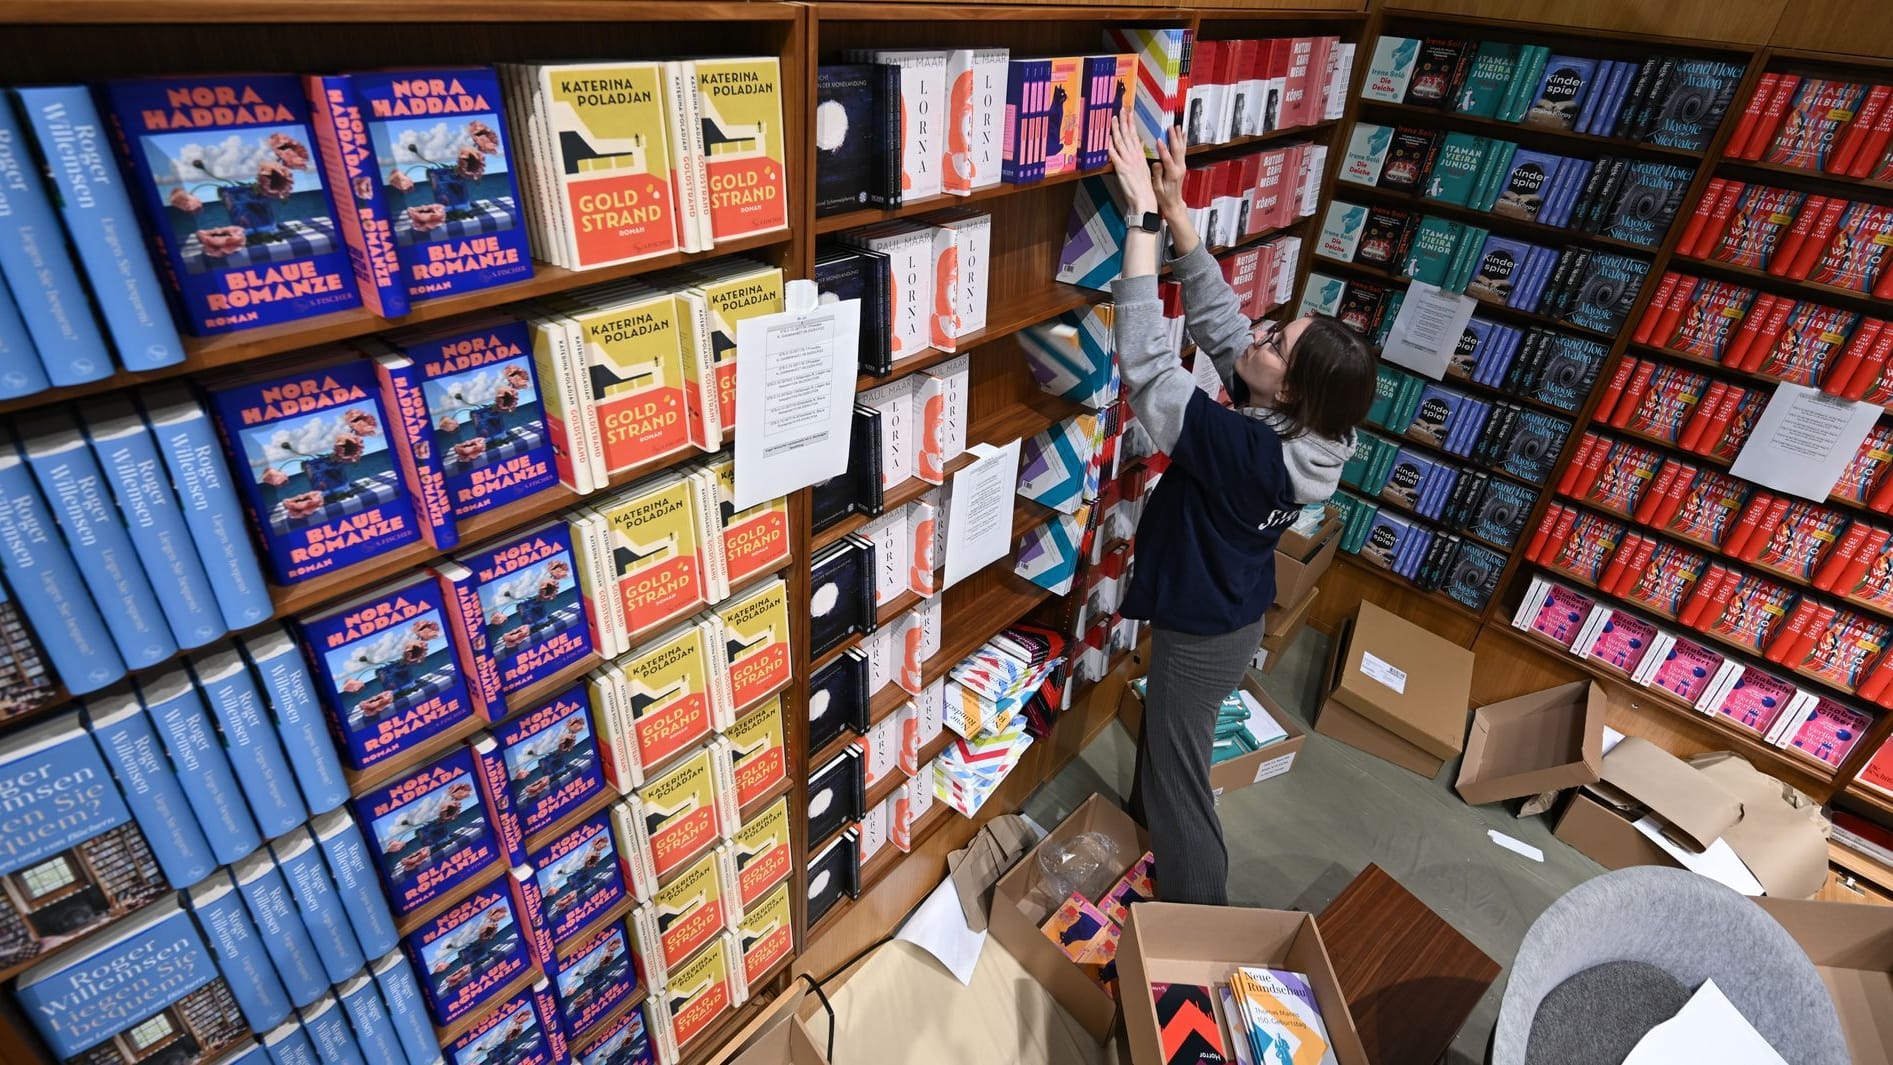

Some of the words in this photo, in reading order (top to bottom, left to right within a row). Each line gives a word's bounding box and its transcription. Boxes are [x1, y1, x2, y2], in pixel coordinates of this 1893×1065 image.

[886, 57, 913, 68] PAUL
[916, 56, 944, 68] MAAR
[982, 54, 1008, 65] MAAR
[1478, 63, 1511, 73] VIEIRA
[1677, 60, 1710, 75] Grand
[1711, 61, 1745, 78] Hotel
[561, 78, 633, 95] KATERINA
[701, 72, 759, 84] KATERINA
[1380, 76, 1391, 84] Die
[1471, 71, 1510, 81] JUNIOR
[1546, 73, 1586, 88] Kinder
[1683, 73, 1723, 90] Avalon
[167, 85, 263, 108] NORA
[394, 79, 467, 97] NORA
[577, 90, 652, 107] POLADJAN
[675, 76, 683, 111] KATERINA
[713, 83, 773, 96] POLADJAN
[1371, 84, 1395, 92] Deiche
[1547, 85, 1576, 96] spiel
[1802, 84, 1865, 98] ELIZABETH
[372, 94, 490, 117] HADDADA
[1803, 96, 1851, 109] GILBERT
[142, 104, 295, 130] HADDADA
[918, 79, 929, 174] LORNA
[983, 75, 993, 163] LORNA
[1662, 119, 1703, 137] Maggie
[1796, 117, 1816, 126] ALL
[1818, 120, 1838, 129] THE
[327, 89, 360, 179] HADDADA
[347, 105, 370, 162] NORA
[679, 112, 688, 151] POLADJAN
[1785, 126, 1816, 138] WAY
[1818, 130, 1835, 141] TO
[75, 124, 109, 184] Roger
[1446, 144, 1482, 157] ITAMAR
[1775, 136, 1795, 147] THE
[1795, 139, 1833, 153] RIVER
[43, 104, 95, 208] Willemsen
[1356, 160, 1368, 168] Die
[1440, 160, 1477, 172] JUNIOR
[1446, 152, 1478, 165] VIEIRA
[710, 171, 758, 191] GOLD
[1511, 168, 1549, 183] Kinder
[1631, 161, 1664, 176] Grand
[1665, 164, 1695, 181] Hotel
[683, 156, 696, 218] GOLDSTRAND
[1512, 177, 1540, 190] spiel
[1638, 175, 1674, 190] Avalon
[579, 190, 638, 213] GOLD
[712, 186, 776, 209] STRAND
[1746, 200, 1790, 214] GILBERT
[581, 207, 661, 233] STRAND
[741, 205, 762, 213] ROMAN
[619, 226, 645, 237] ROMAN
[1620, 214, 1656, 231] Maggie
[1740, 218, 1760, 229] ALL
[1761, 222, 1780, 233] THE
[378, 219, 400, 273] BLAUE
[877, 241, 900, 251] PAUL
[904, 233, 931, 244] MAAR
[1722, 236, 1739, 246] THE
[1742, 239, 1774, 254] RIVER
[1731, 227, 1760, 238] WAY
[1761, 232, 1776, 243] TO
[361, 208, 392, 288] ROMANZE
[428, 236, 501, 263] BLAUE
[412, 249, 519, 281] ROMANZE
[1483, 254, 1519, 269] Kinder
[1484, 263, 1511, 276] spiel
[225, 261, 317, 289] BLAUE
[206, 274, 343, 311] ROMANZE
[408, 281, 452, 294] ROMAN
[712, 285, 763, 304] KATERINA
[907, 256, 917, 335] LORNA
[722, 291, 777, 312] POLADJAN
[205, 311, 258, 328] ROMAN
[591, 314, 654, 336] KATERINA
[604, 320, 669, 344] POLADJAN
[442, 337, 506, 359] NORA
[425, 342, 522, 377] HADDADA
[261, 375, 341, 404] NORA
[241, 385, 368, 424] HADDADA
[605, 403, 657, 429] GOLD
[607, 412, 677, 445] STRAND
[891, 402, 900, 469] LORNA
[171, 432, 208, 511] Willemsen
[195, 444, 220, 489] Roger
[471, 455, 530, 486] BLAUE
[112, 447, 153, 528] Willemsen
[137, 459, 166, 505] Roger
[457, 461, 547, 503] ROMANZE
[456, 499, 491, 516] ROMAN
[614, 497, 670, 525] KATERINA
[626, 500, 683, 529] POLADJAN
[305, 508, 383, 544] BLAUE
[290, 516, 404, 564] ROMANZE
[288, 558, 333, 578] ROMAN
[626, 571, 671, 599] GOLD
[628, 575, 690, 612] STRAND
[344, 597, 411, 628] NORA
[727, 597, 770, 623] KATERINA
[736, 598, 781, 626] POLADJAN
[327, 600, 432, 648] HADDADA
[1614, 620, 1645, 637] Gilbert
[1677, 648, 1710, 666] Gilbert
[271, 664, 300, 724] Willemsen
[290, 669, 309, 705] Roger
[364, 700, 460, 752] ROMANZE
[378, 697, 442, 734] BLAUE
[1819, 708, 1857, 729] Gilbert
[656, 819, 694, 849] GOLD
[657, 819, 709, 859] STRAND
[70, 939, 155, 990] Roger
[40, 938, 189, 1016] Willemsen
[1244, 971, 1271, 982] Neue
[51, 977, 149, 1032] Liegen
[157, 950, 198, 978] Sie
[68, 963, 195, 1037] bequem?
[1247, 982, 1307, 997] Rundschau
[1255, 1008, 1279, 1016] Thomas
[1271, 1017, 1307, 1029] Geburtstag
[1200, 1051, 1222, 1061] Horror
